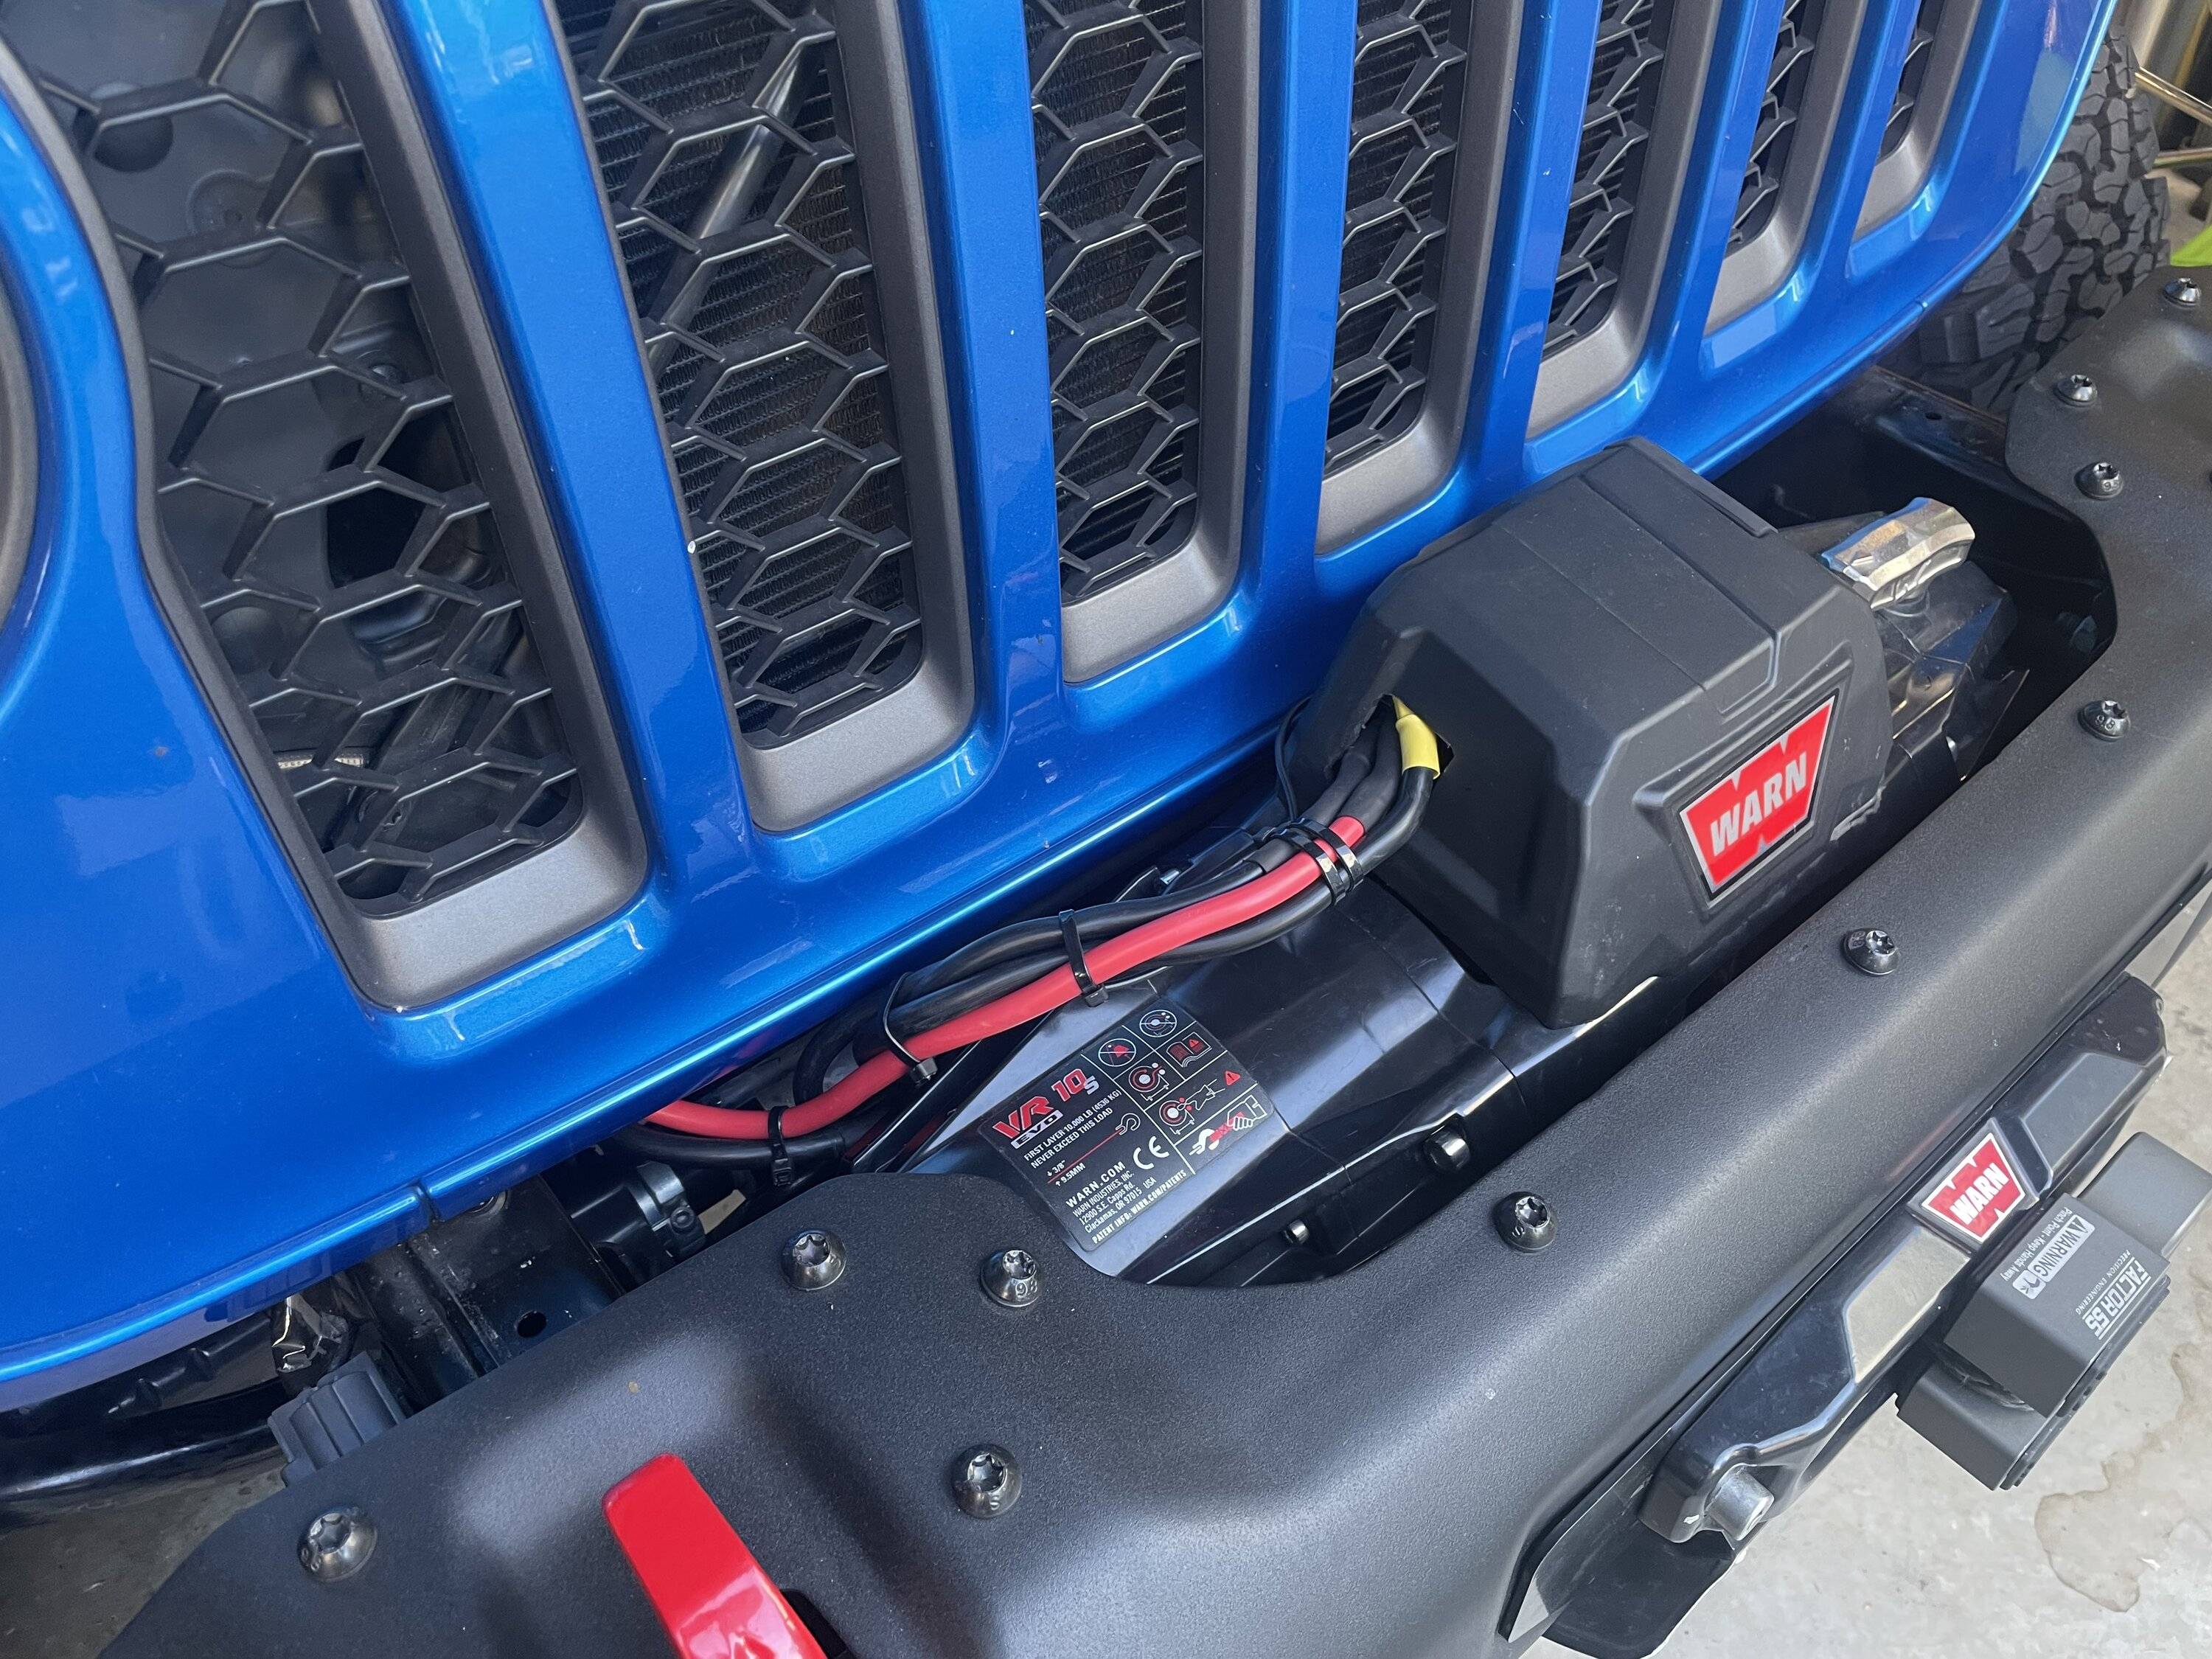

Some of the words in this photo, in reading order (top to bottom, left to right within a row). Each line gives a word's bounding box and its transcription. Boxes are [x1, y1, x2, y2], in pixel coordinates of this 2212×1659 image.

[1710, 751, 1807, 857] WARN
[992, 1096, 1054, 1139] VR
[1015, 1113, 1059, 1145] EVO
[1023, 1144, 1044, 1161] FIRST
[1043, 1129, 1066, 1147] LAYER
[1063, 1115, 1085, 1132] 10,000
[1082, 1109, 1093, 1119] LB
[1092, 1098, 1110, 1113] (4536
[1107, 1089, 1122, 1101] KG)
[1030, 1150, 1055, 1169] NEVER
[1053, 1131, 1080, 1152] EXCEED
[1077, 1120, 1096, 1134] THIS
[1093, 1107, 1113, 1123] LOAD
[1061, 1162, 1086, 1183] 9.5MM
[1065, 1161, 1126, 1208] WARN.COM
[1072, 1201, 1091, 1217] WARN
[1088, 1179, 1124, 1206] INDUSTRIES,
[1121, 1170, 1134, 1181] INC.
[1115, 1200, 1126, 1210] OR
[1123, 1186, 1142, 1204] 97015
[1143, 1176, 1157, 1189] USA
[1949, 1162, 2009, 1225] WARN
[1079, 1208, 1098, 1225] 12900
[1107, 1189, 1126, 1203] Capps
[1123, 1181, 1135, 1192] Rd.
[1091, 1223, 1115, 1244] PATENT
[1113, 1212, 1133, 1227] INFO:
[1130, 1169, 1187, 1214] WARN.COM/PATENTS
[2053, 1207, 2073, 1223] Pinch
[2027, 1237, 2046, 1251] Keep
[2042, 1220, 2061, 1236] Point
[2000, 1264, 2020, 1281] Away
[2014, 1251, 2033, 1269] Hands
[2034, 1232, 2081, 1276] WARNING
[2107, 1250, 2131, 1278] PRECISION
[2075, 1277, 2108, 1315] ENGINEERING
[2101, 1259, 2149, 1317] FACTOR
